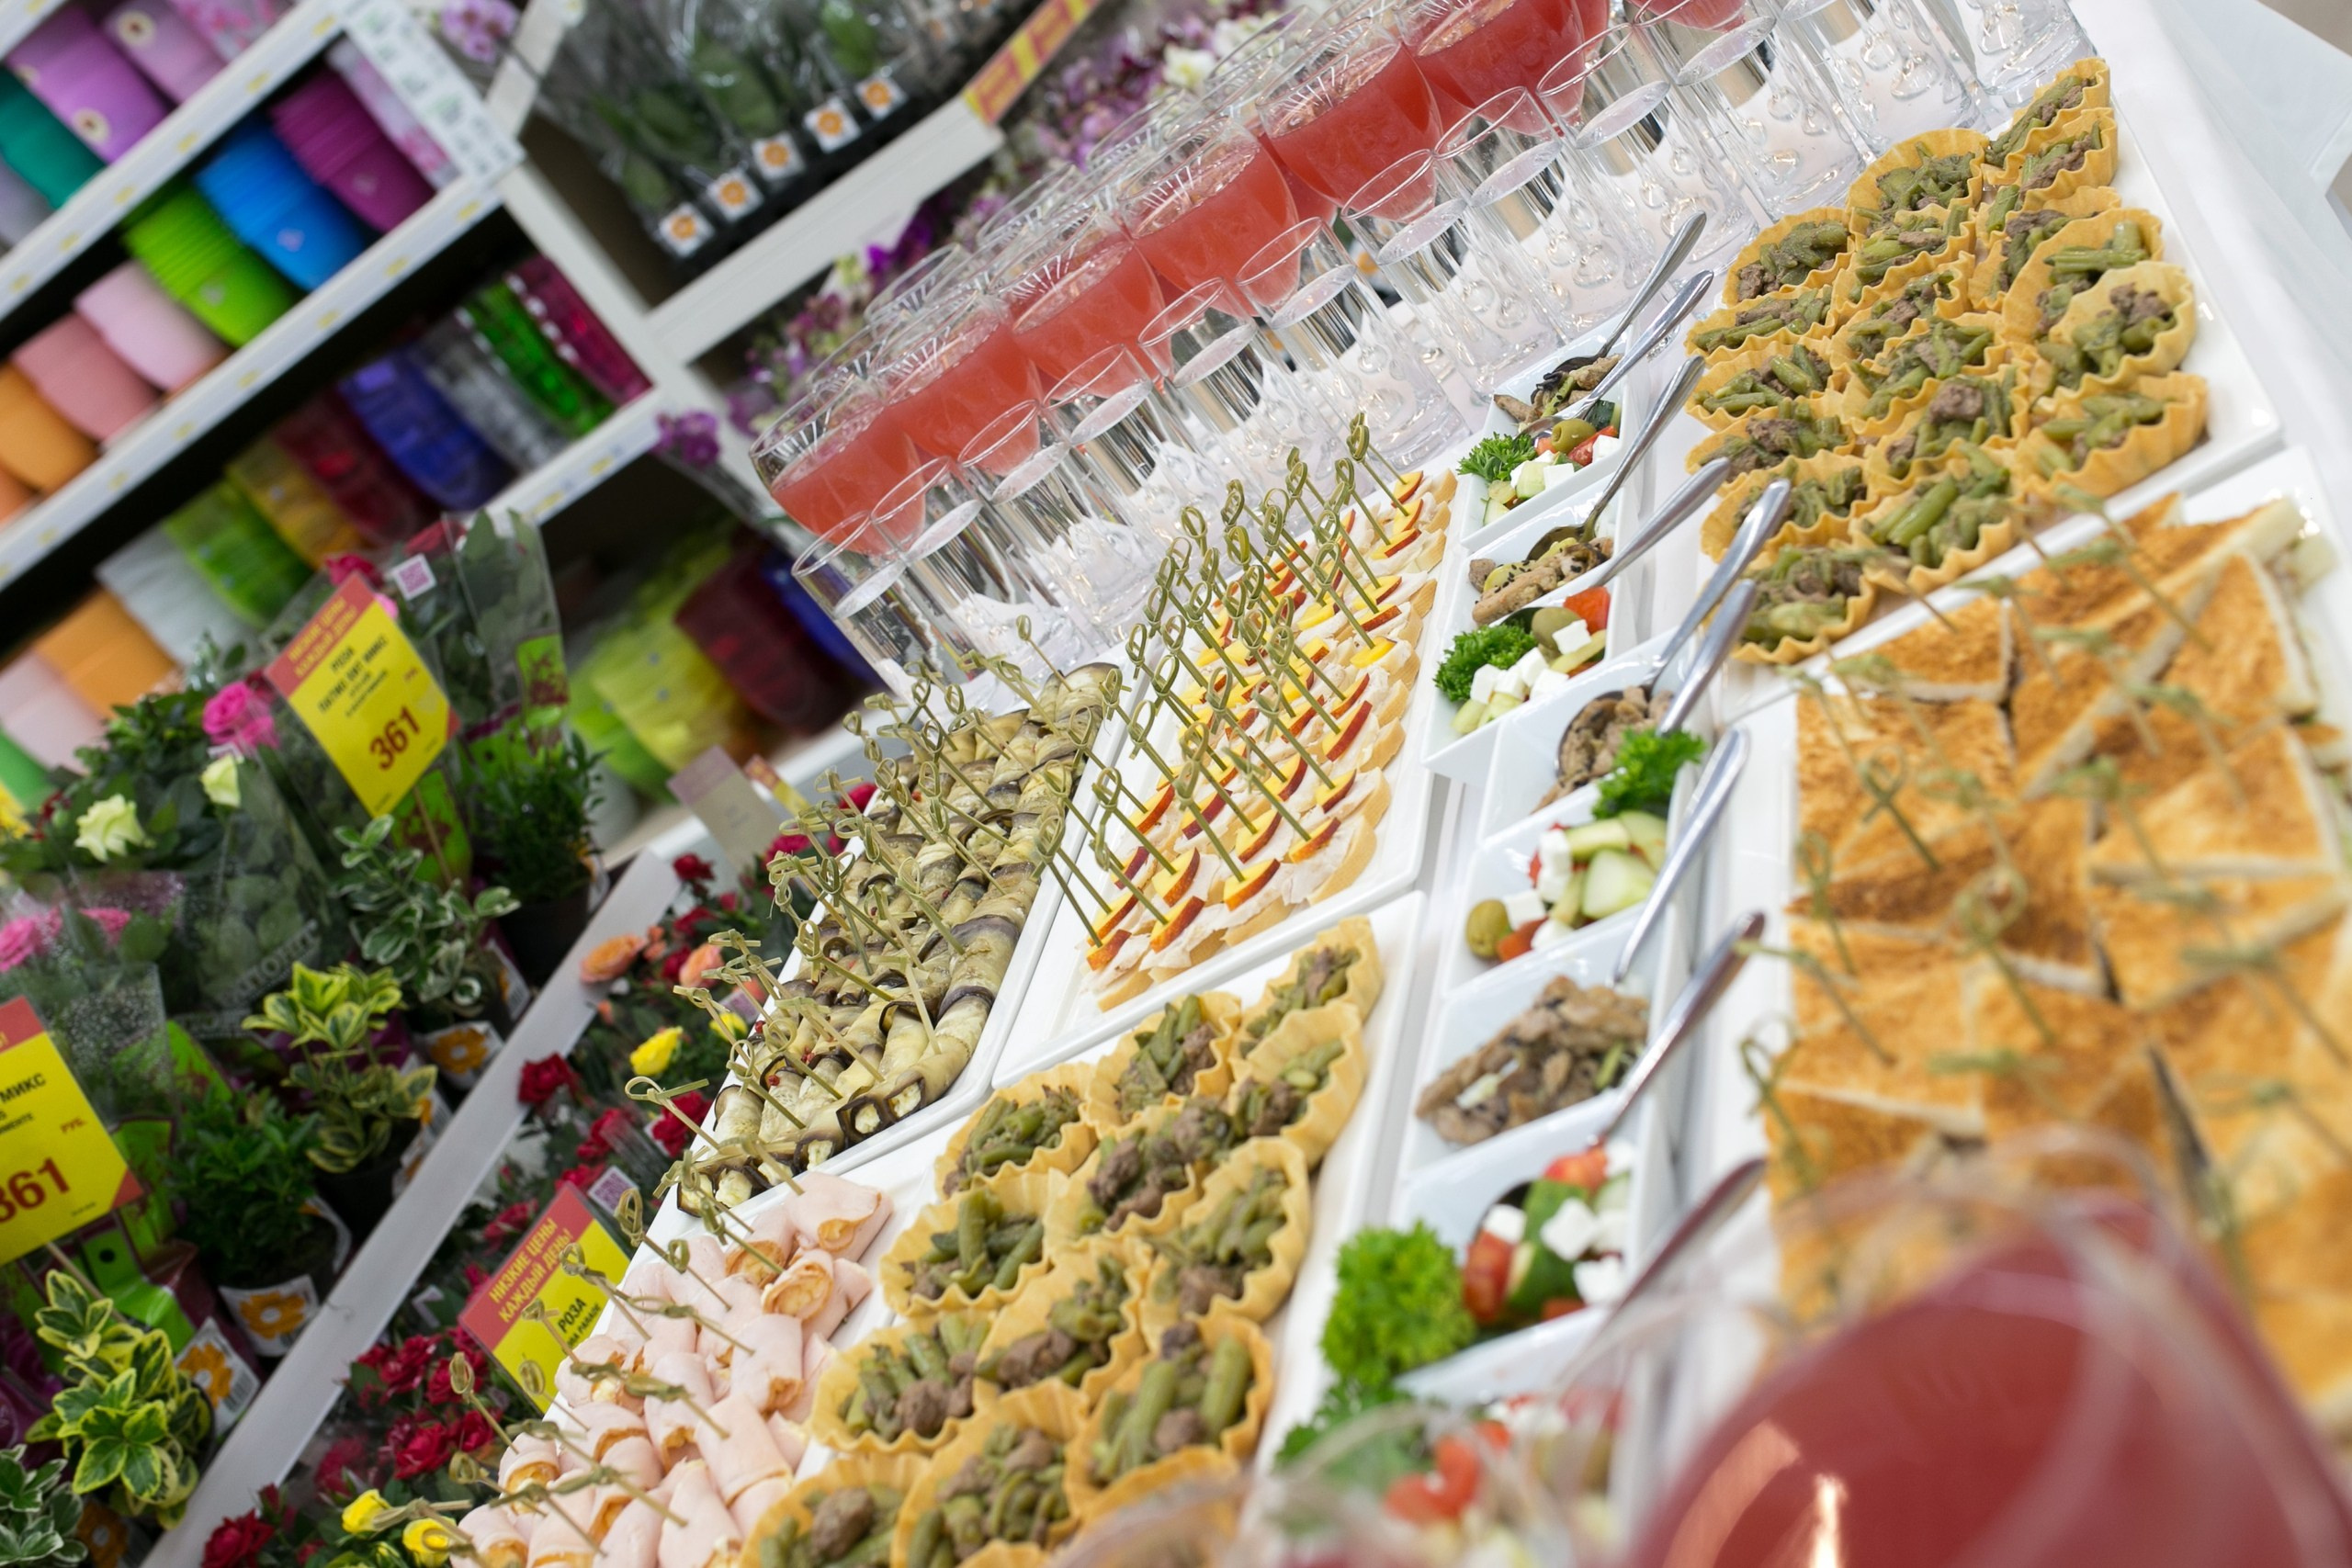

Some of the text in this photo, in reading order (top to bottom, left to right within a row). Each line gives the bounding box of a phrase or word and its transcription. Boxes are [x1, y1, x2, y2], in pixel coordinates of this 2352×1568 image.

[369, 705, 421, 771] 361
[489, 1216, 558, 1304] НИЗКИЕ ЦЕНЫ
[498, 1227, 574, 1324] КАЖДЫЙ ДЕНЬ!
[557, 1297, 587, 1334] РОЗА
